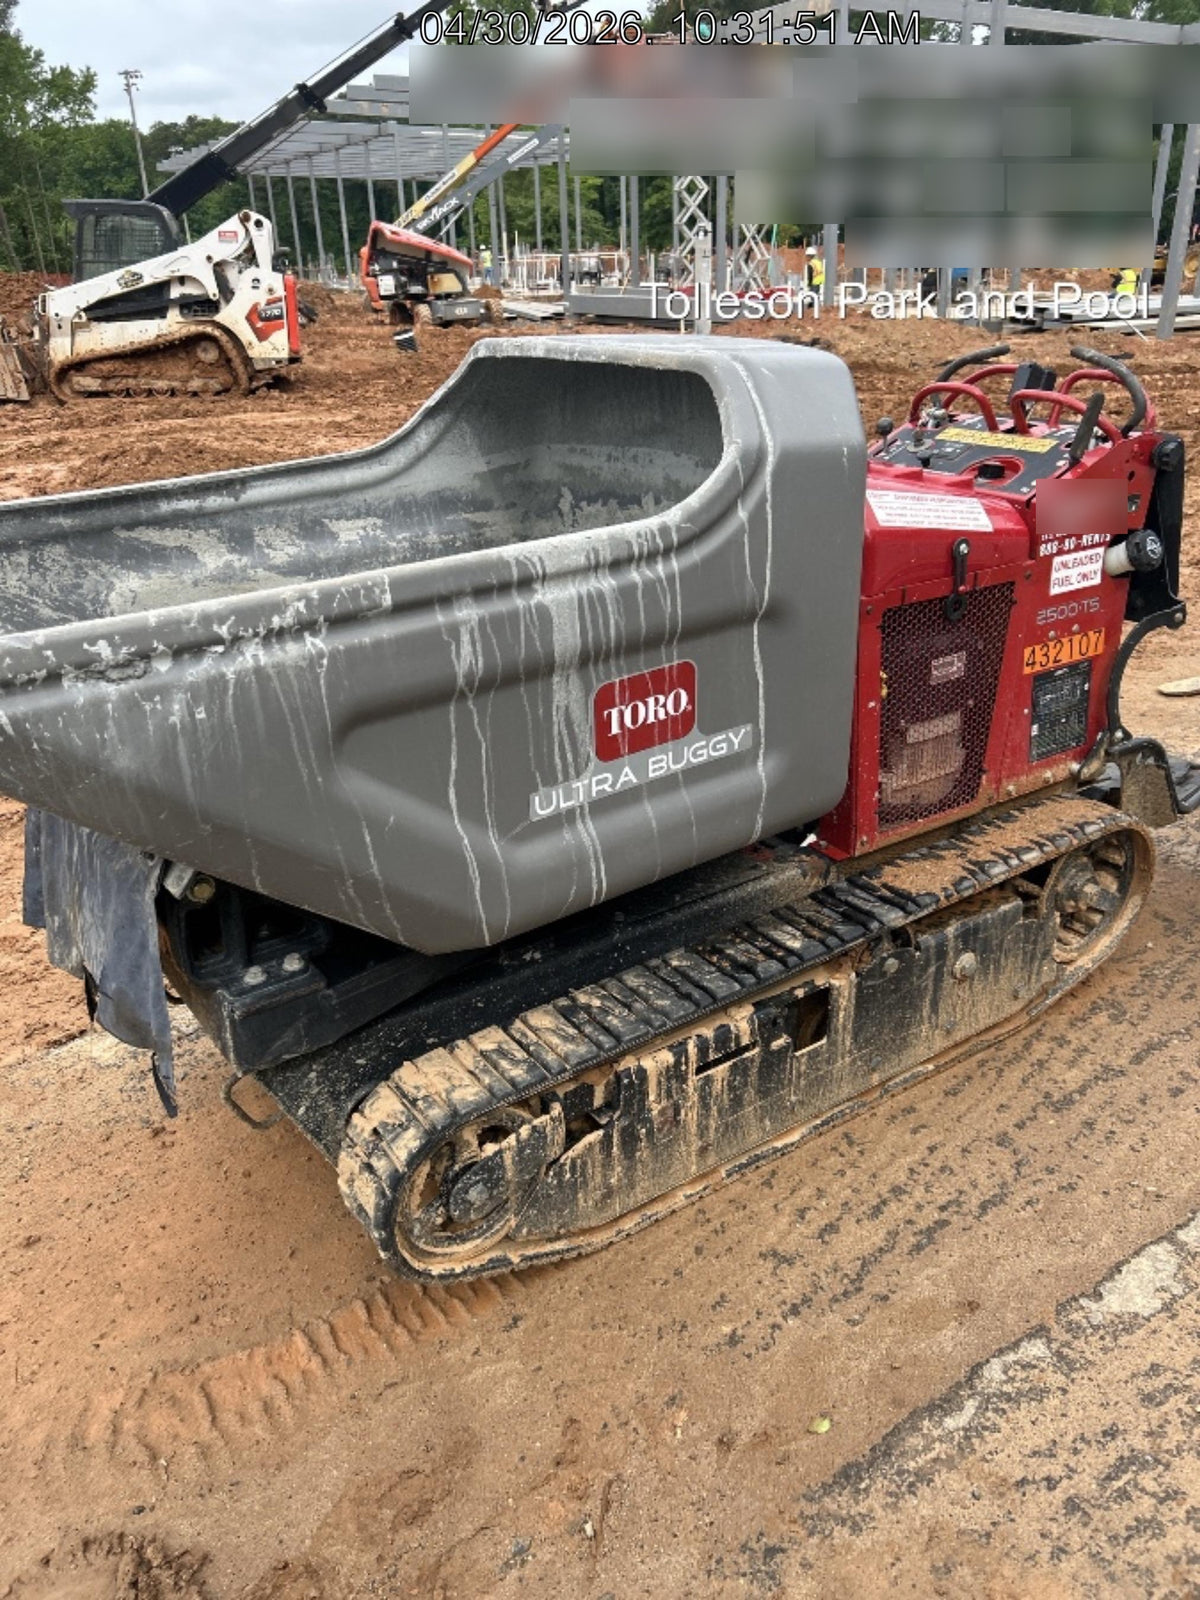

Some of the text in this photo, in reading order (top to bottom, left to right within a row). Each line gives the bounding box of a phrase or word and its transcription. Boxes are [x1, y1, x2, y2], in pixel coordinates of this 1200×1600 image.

[1052, 570, 1100, 590] FUEL ONLY
[1054, 552, 1102, 573] UNLEADED
[1025, 630, 1103, 670] 432107
[604, 687, 689, 737] TORO
[534, 727, 746, 816] ULTRA BUGGY
